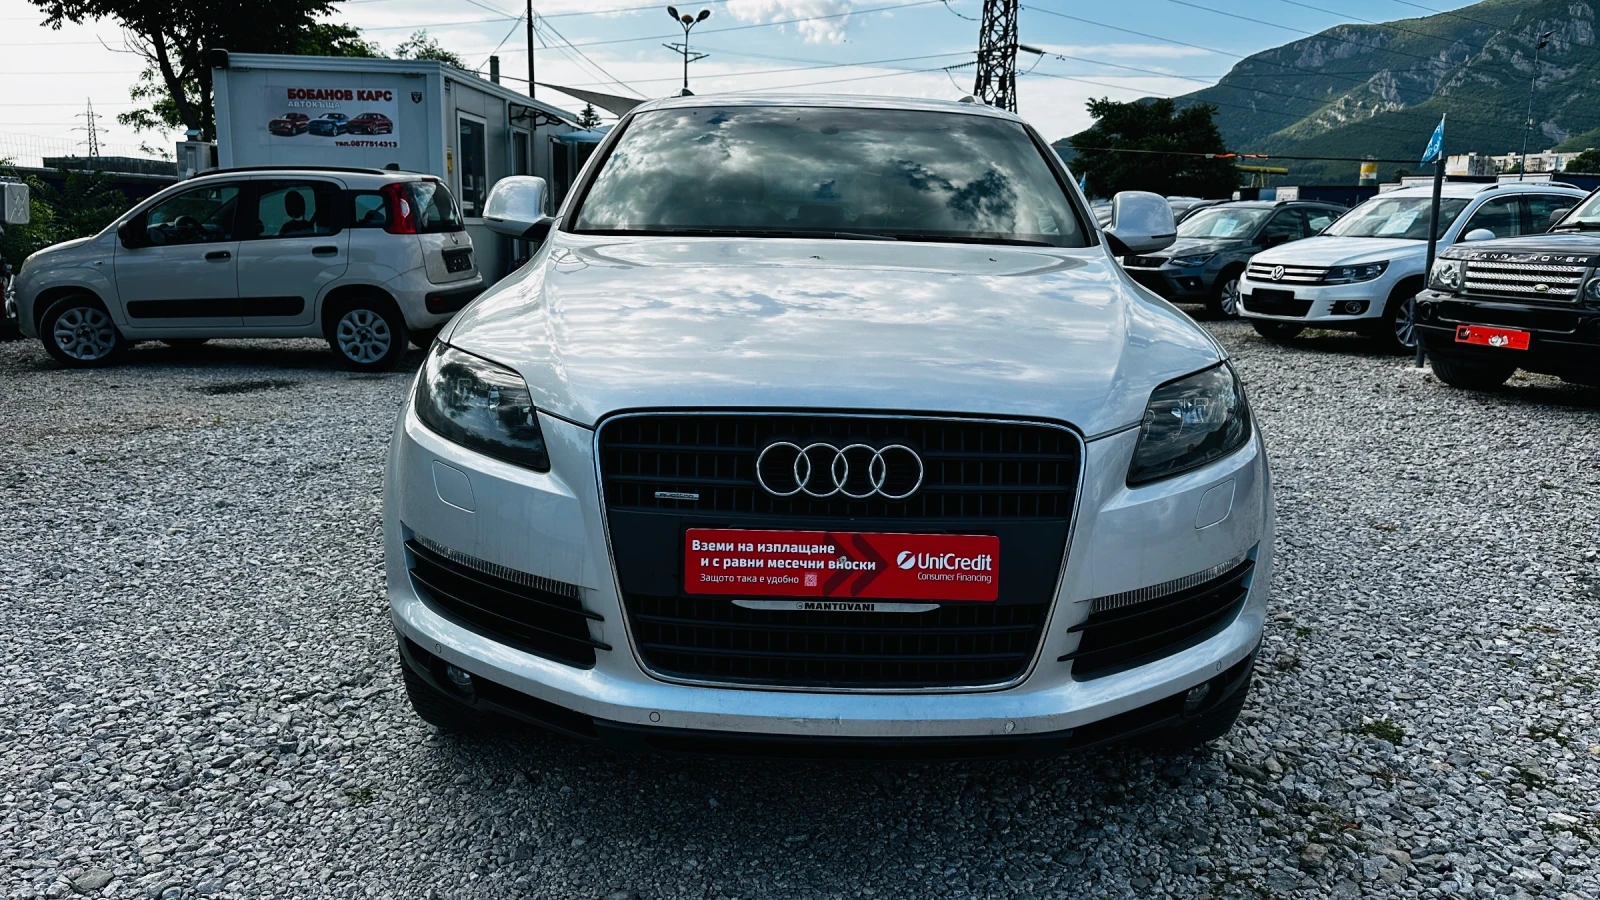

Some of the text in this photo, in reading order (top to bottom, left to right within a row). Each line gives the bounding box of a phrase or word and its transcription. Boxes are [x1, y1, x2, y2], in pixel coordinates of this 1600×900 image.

[287, 88, 393, 102] БОБАНОВ КАРС
[288, 101, 341, 109] АВТОКЪЩА
[1529, 255, 1589, 263] ROVER
[691, 539, 836, 556] Вземи на изплащане
[700, 557, 876, 571] и с равни месечни вноски
[917, 552, 993, 571] UniCredit
[700, 573, 800, 584] Защото така е удобно
[917, 571, 992, 585] Consumer Financing
[804, 602, 875, 611] MANTOVANI
